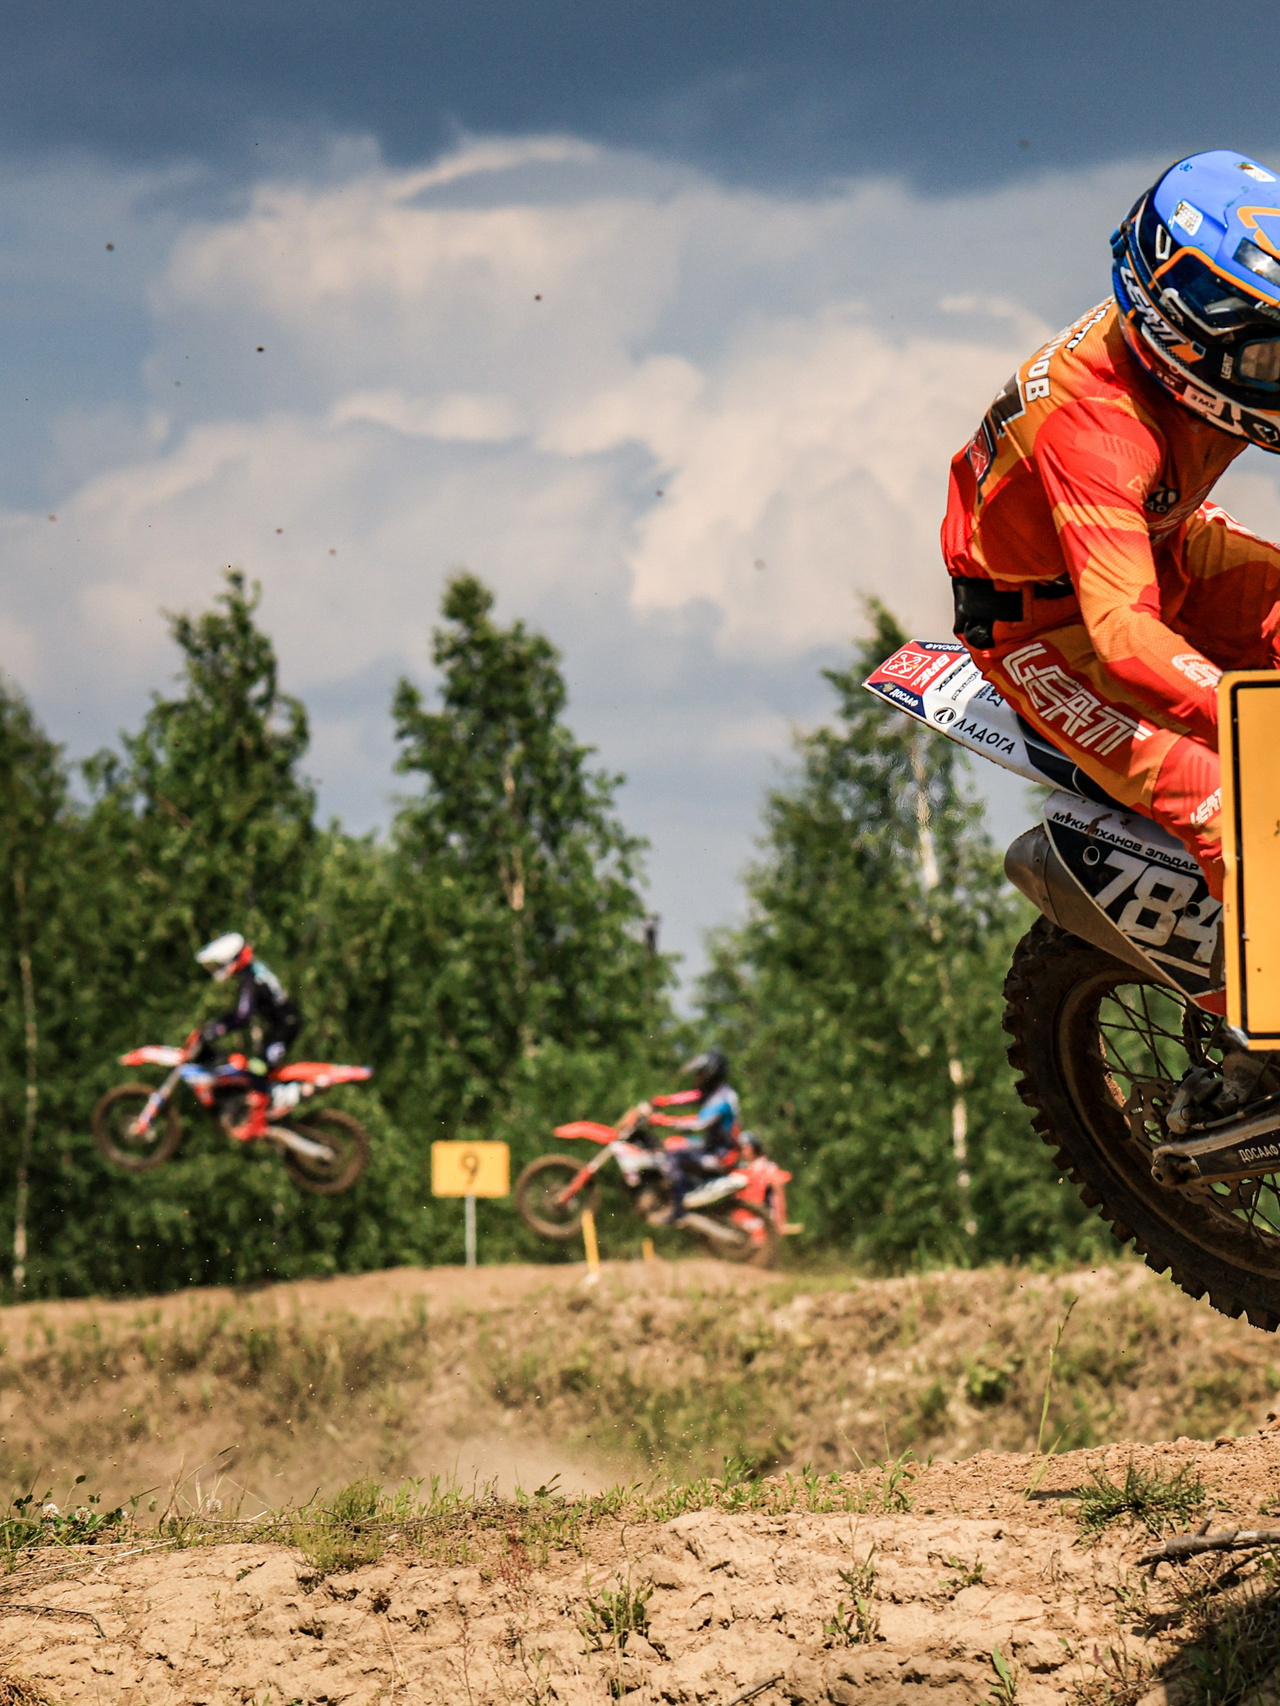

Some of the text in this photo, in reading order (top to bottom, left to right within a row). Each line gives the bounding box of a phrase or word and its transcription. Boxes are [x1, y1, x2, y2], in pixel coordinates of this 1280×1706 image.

[1120, 266, 1188, 346] LEATT
[1002, 642, 1154, 757] LEATT
[953, 718, 1015, 755] ЛАДОГА
[1145, 846, 1199, 872] ЭЛЬДАР
[1094, 849, 1224, 966] 784
[459, 1150, 480, 1184] 9
[1237, 1141, 1279, 1162] ДОСААФ
